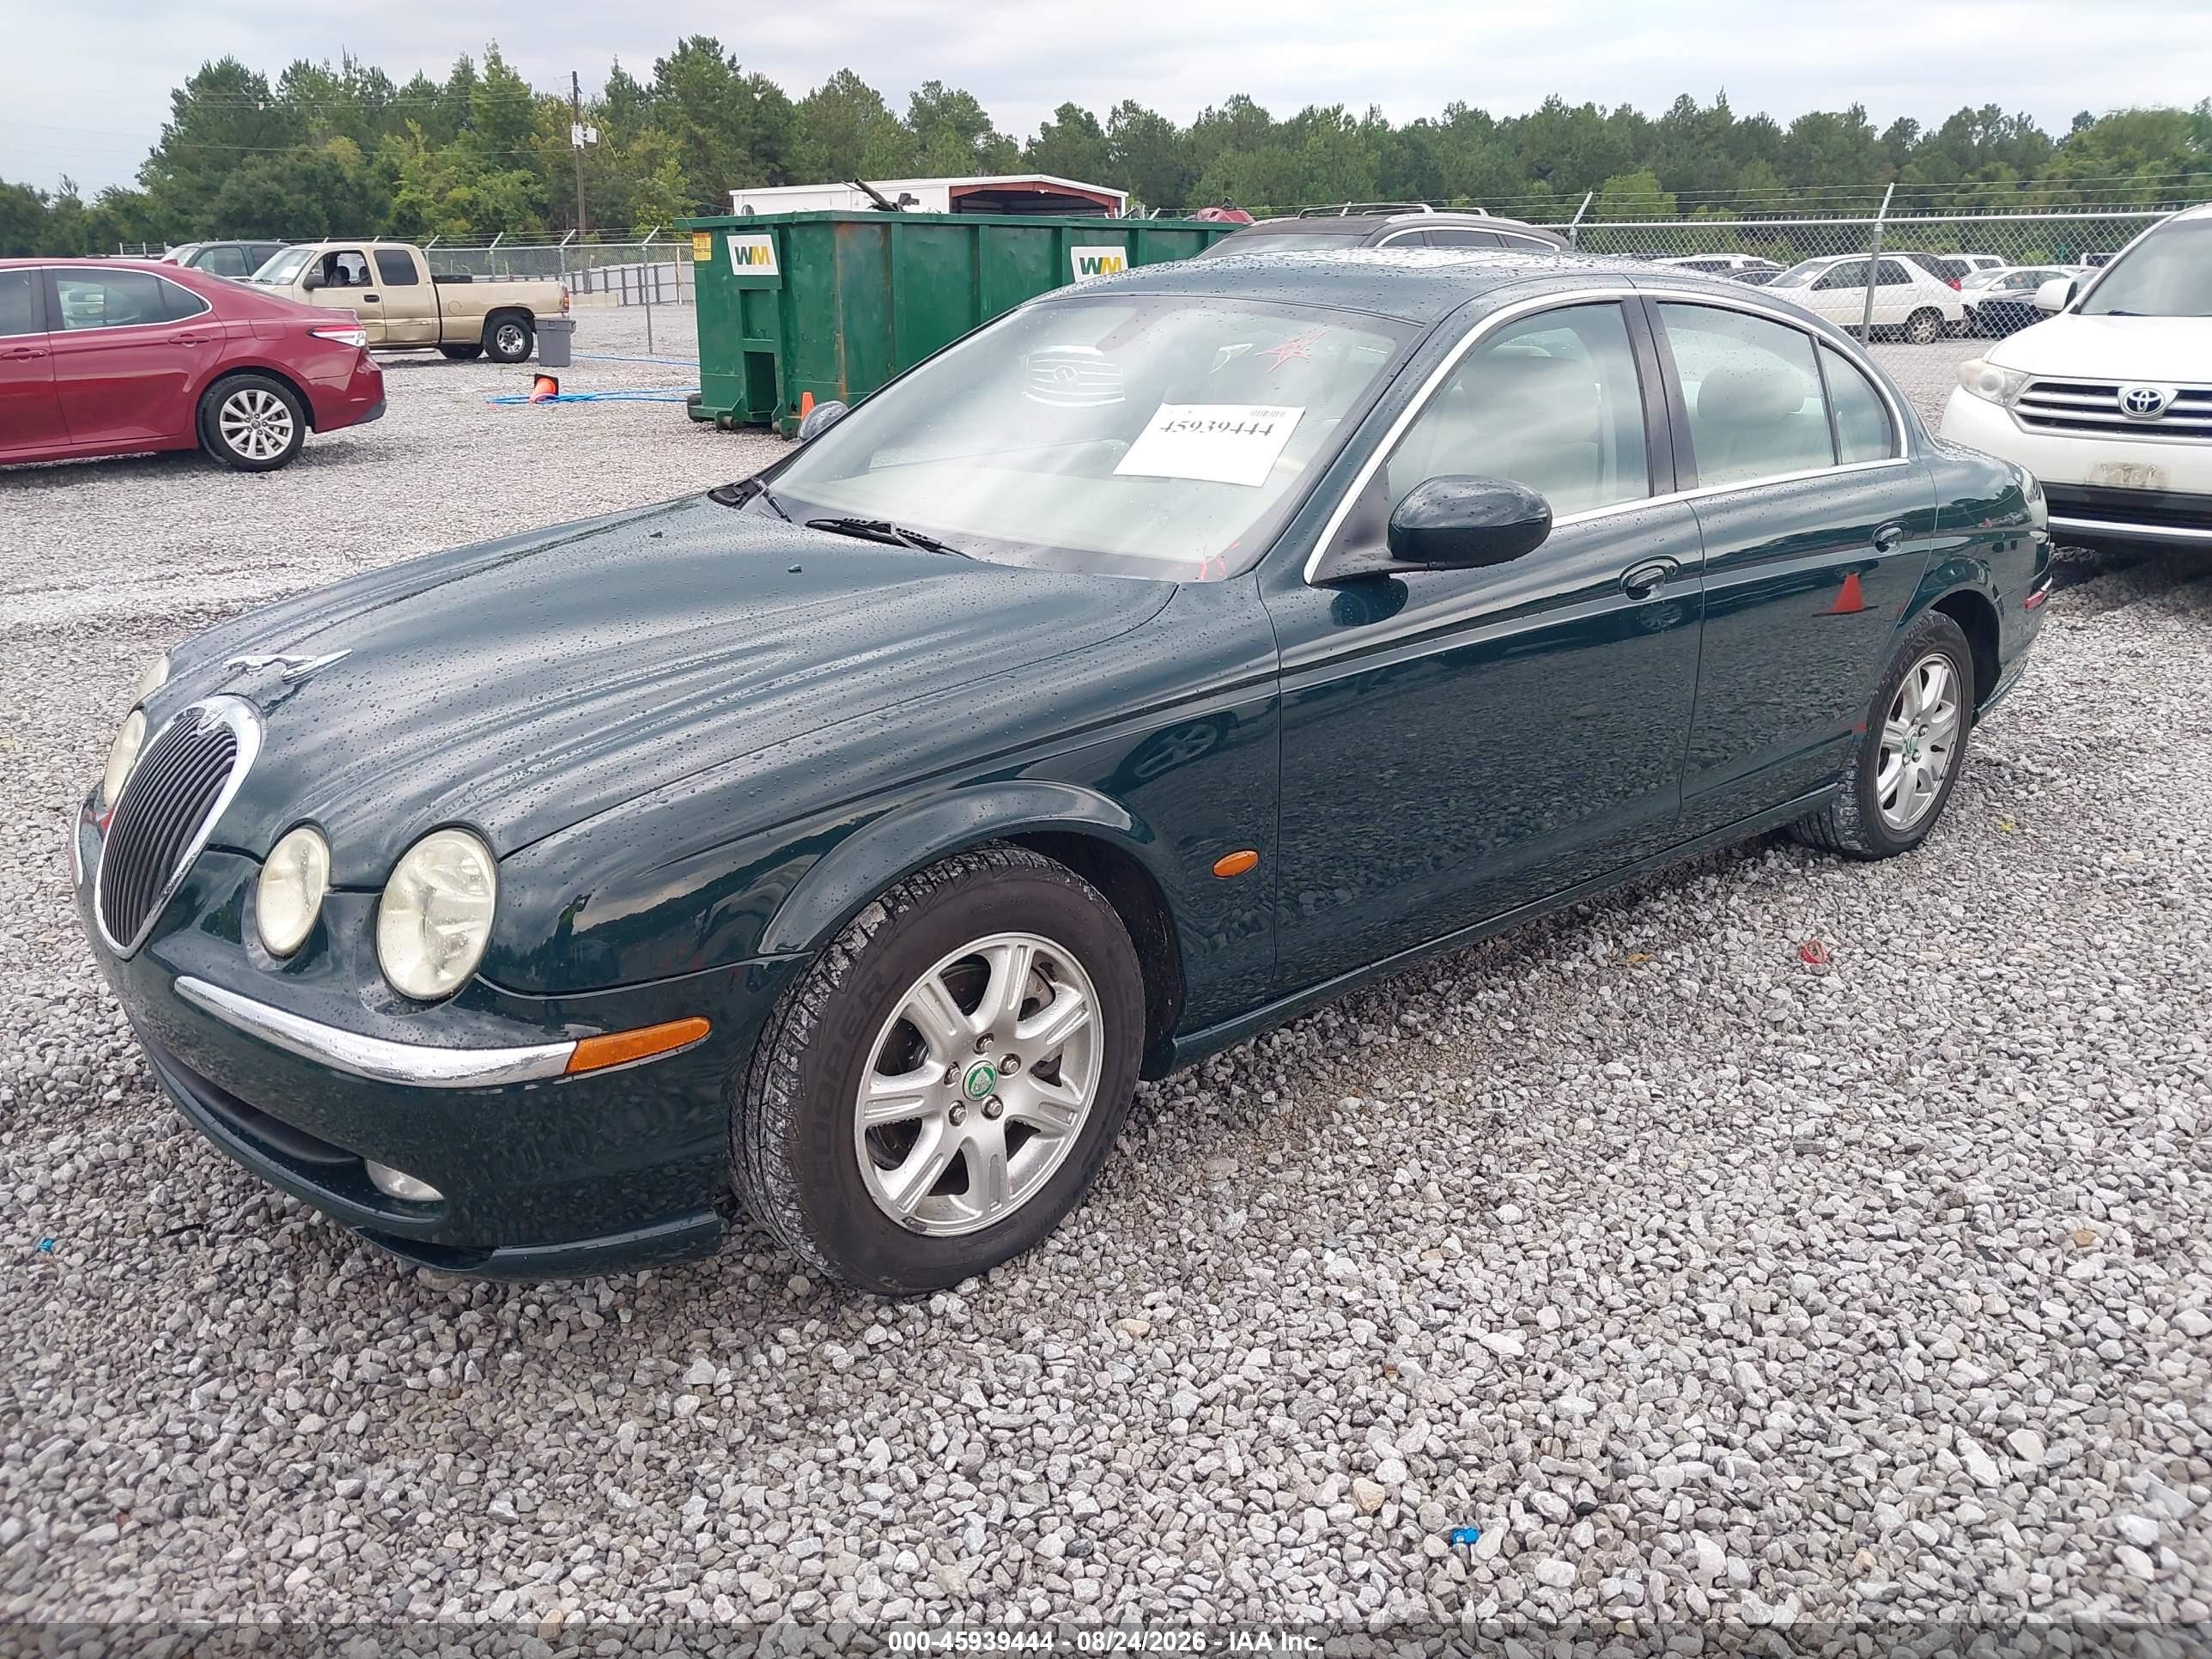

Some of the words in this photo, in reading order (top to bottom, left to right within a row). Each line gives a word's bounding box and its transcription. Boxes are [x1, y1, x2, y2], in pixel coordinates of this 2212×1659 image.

[734, 246, 771, 265] WM
[1079, 257, 1123, 276] WM
[1160, 420, 1275, 436] 45939444
